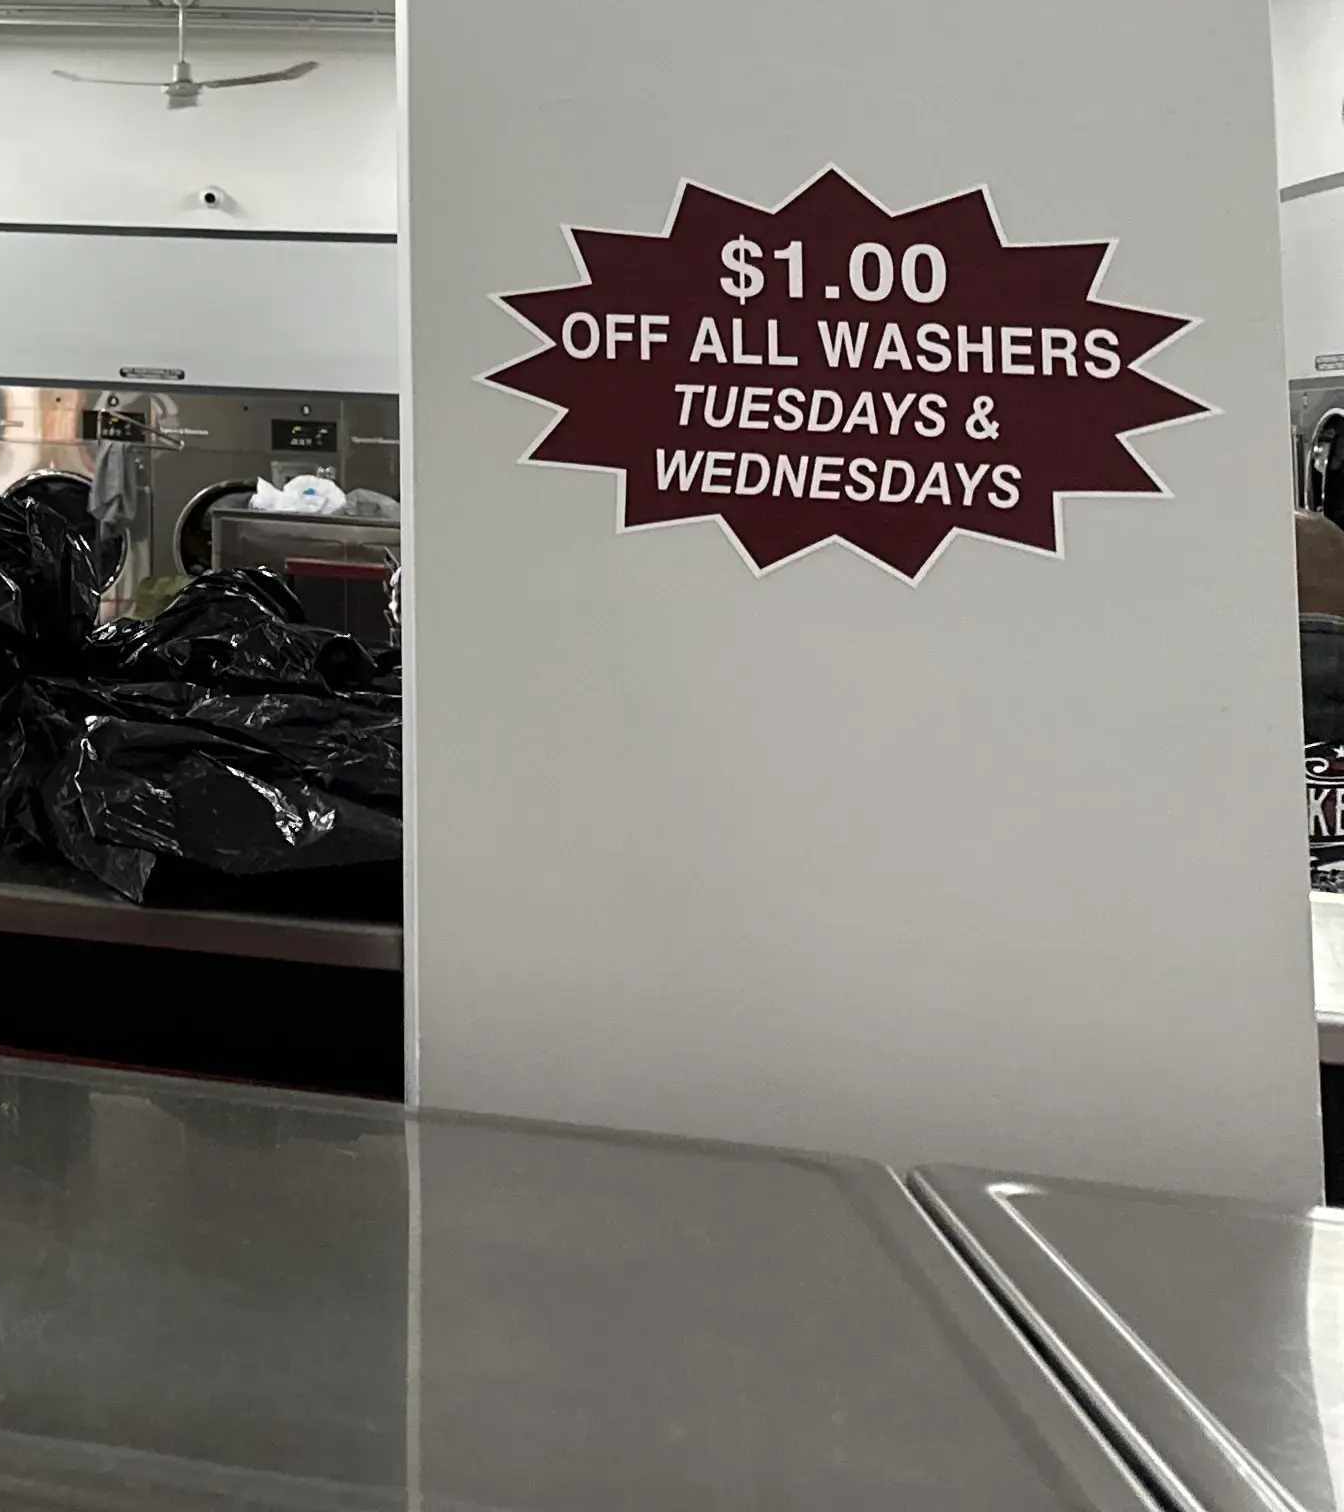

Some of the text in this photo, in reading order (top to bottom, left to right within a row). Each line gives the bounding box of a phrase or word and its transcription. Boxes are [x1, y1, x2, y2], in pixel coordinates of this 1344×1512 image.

[719, 233, 948, 306] $1.00
[561, 311, 1122, 379] OFF ALL WASHERS
[674, 383, 1000, 440] TUESDAYS &
[655, 448, 1023, 509] WEDNESDAYS
